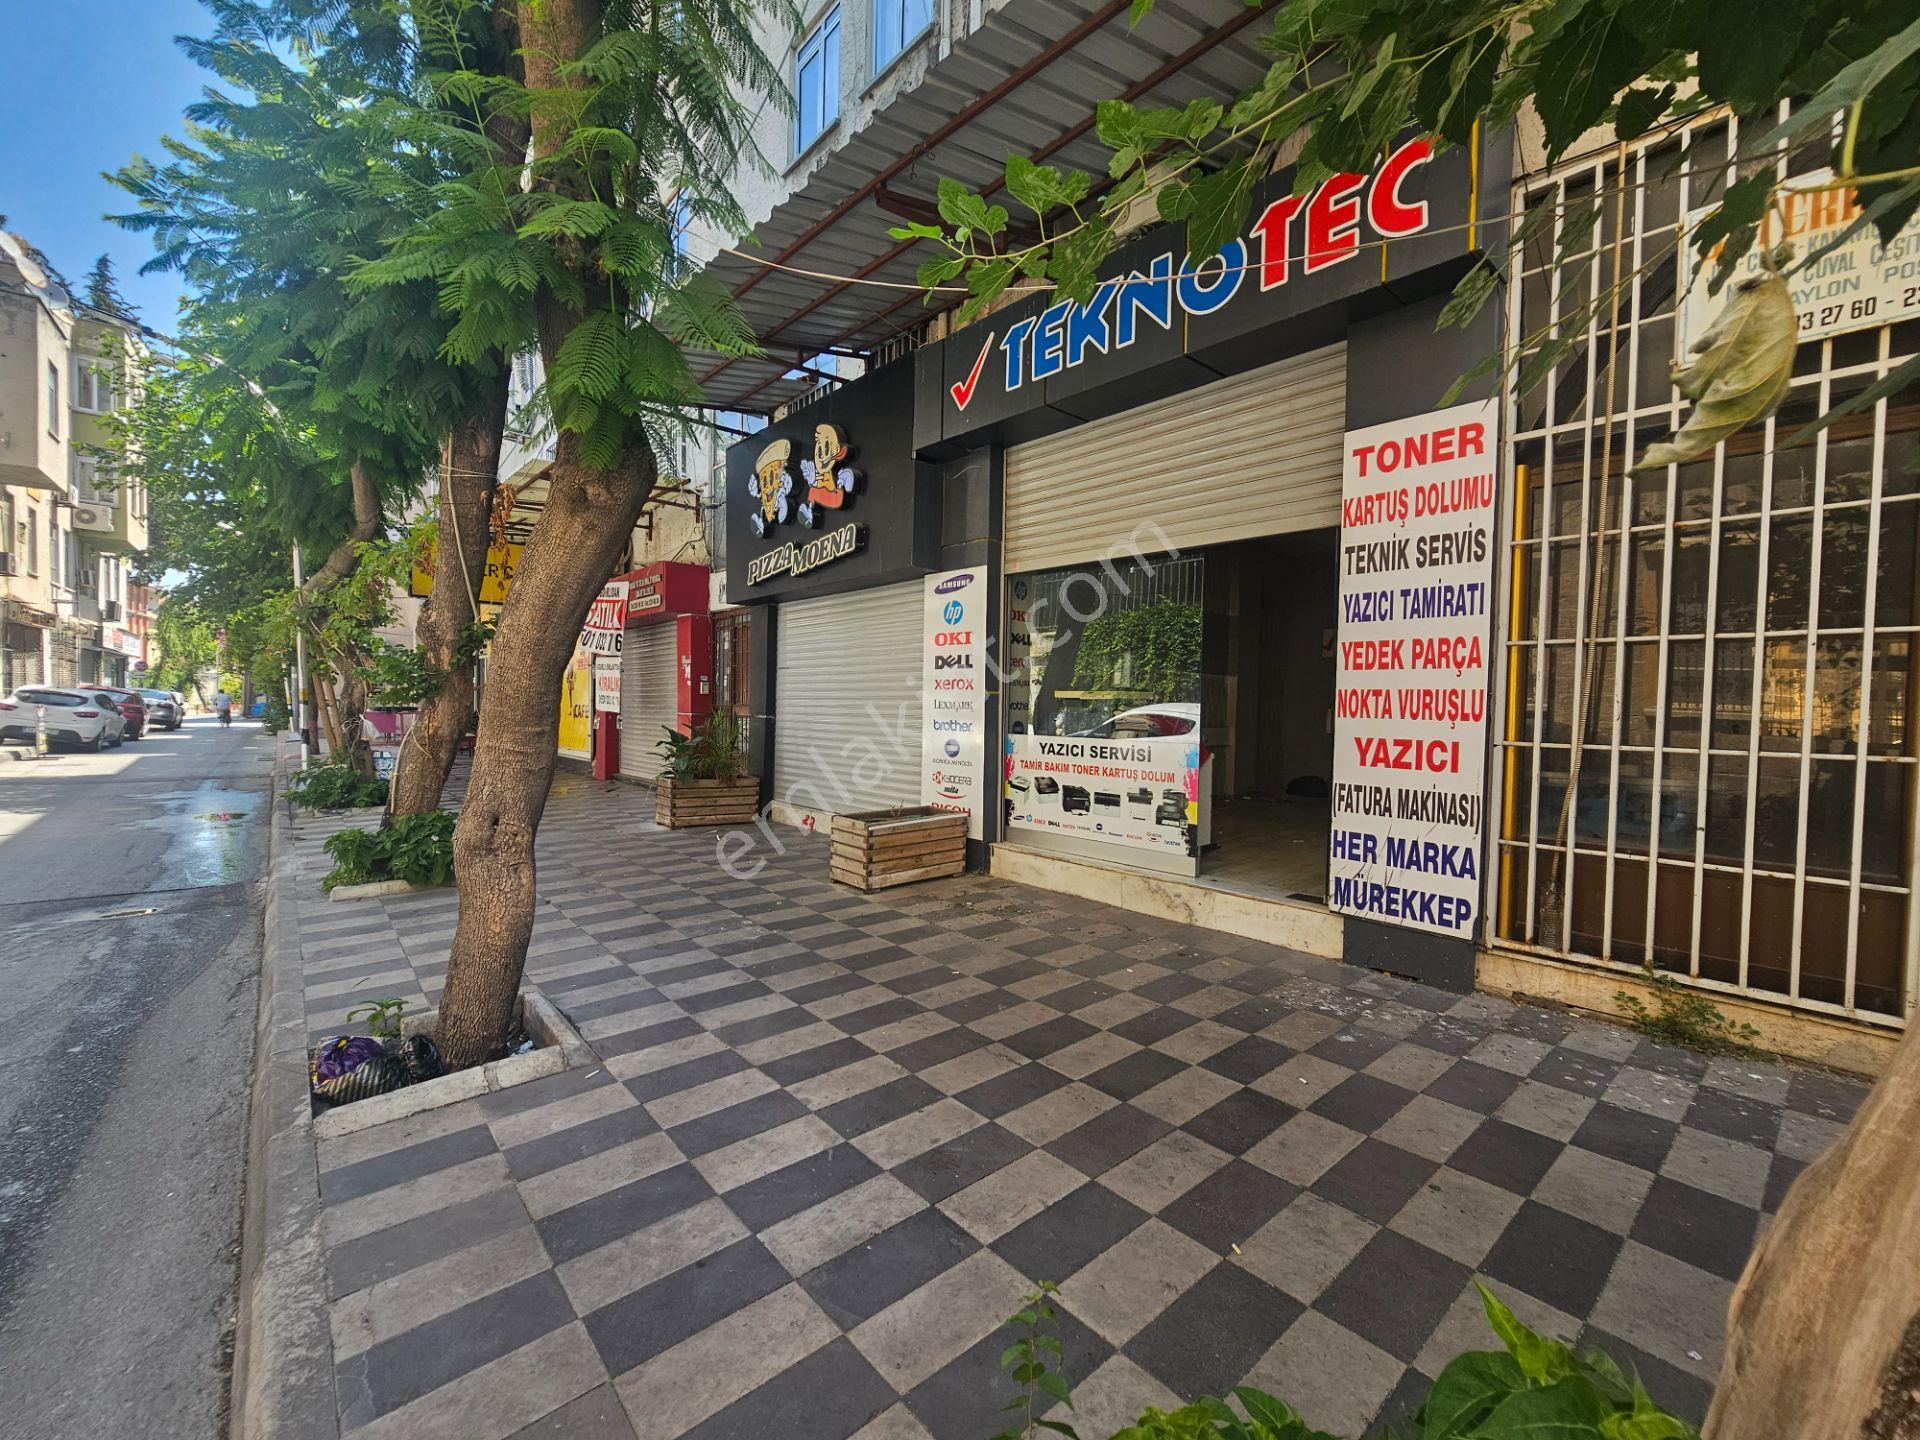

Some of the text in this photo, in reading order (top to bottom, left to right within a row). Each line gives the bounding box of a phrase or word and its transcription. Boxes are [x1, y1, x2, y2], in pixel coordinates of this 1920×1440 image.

[999, 138, 1435, 392] TEKNOTEC
[1790, 275, 1862, 305] AYLON
[1820, 304, 1845, 327] 27
[1850, 297, 1878, 320] 60
[1352, 422, 1484, 477] TONER
[1342, 472, 1493, 528] KARTUŞ DOLUMU
[747, 523, 857, 585] PIZZA MOENA
[1345, 522, 1486, 576] TEKNİK SERVİS
[946, 600, 963, 625] hp
[1343, 577, 1485, 624] YAZICI TAMİRATI
[934, 631, 973, 647] OKI
[1341, 636, 1482, 678] YEDEK PARÇA
[934, 654, 974, 670] DELL
[934, 679, 975, 690] xerox
[934, 699, 975, 712] LEXMARK
[1337, 688, 1483, 729] NOKTA VURUŞLU
[933, 720, 974, 733] brother
[1020, 759, 1175, 784] TAMİR BAKIM TONER KARTUŞ DOLUM
[1039, 742, 1152, 763] YAZICI SERVİSİ
[1353, 736, 1460, 774] YAZICI
[1332, 782, 1481, 835] (FATURA MAKİNASI)
[1332, 829, 1477, 881] HER MARKA
[1333, 873, 1473, 930] MÜREKKEP
